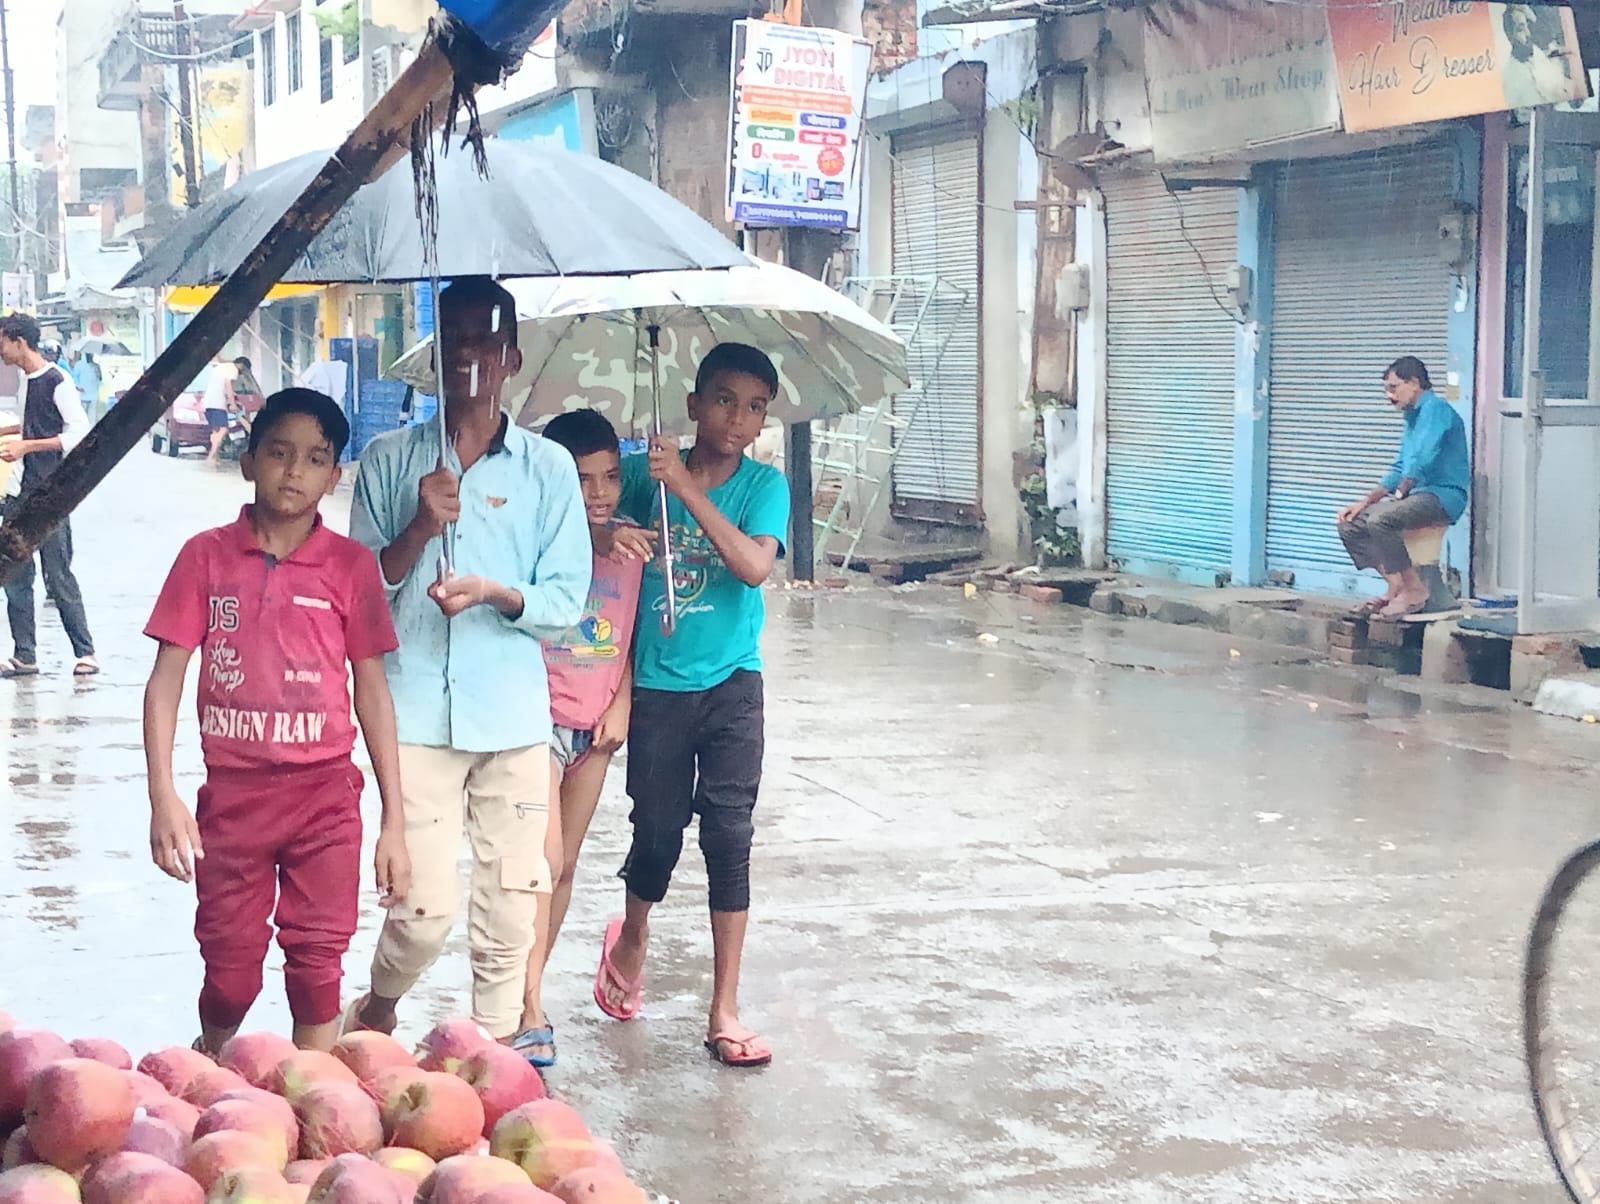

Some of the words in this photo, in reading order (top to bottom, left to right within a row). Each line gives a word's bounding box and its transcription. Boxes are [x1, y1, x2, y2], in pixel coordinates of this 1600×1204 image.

[773, 67, 846, 91] DIGITAL
[1349, 44, 1400, 109] Hair
[1409, 36, 1495, 94] Dresser
[272, 711, 327, 743] RAW
